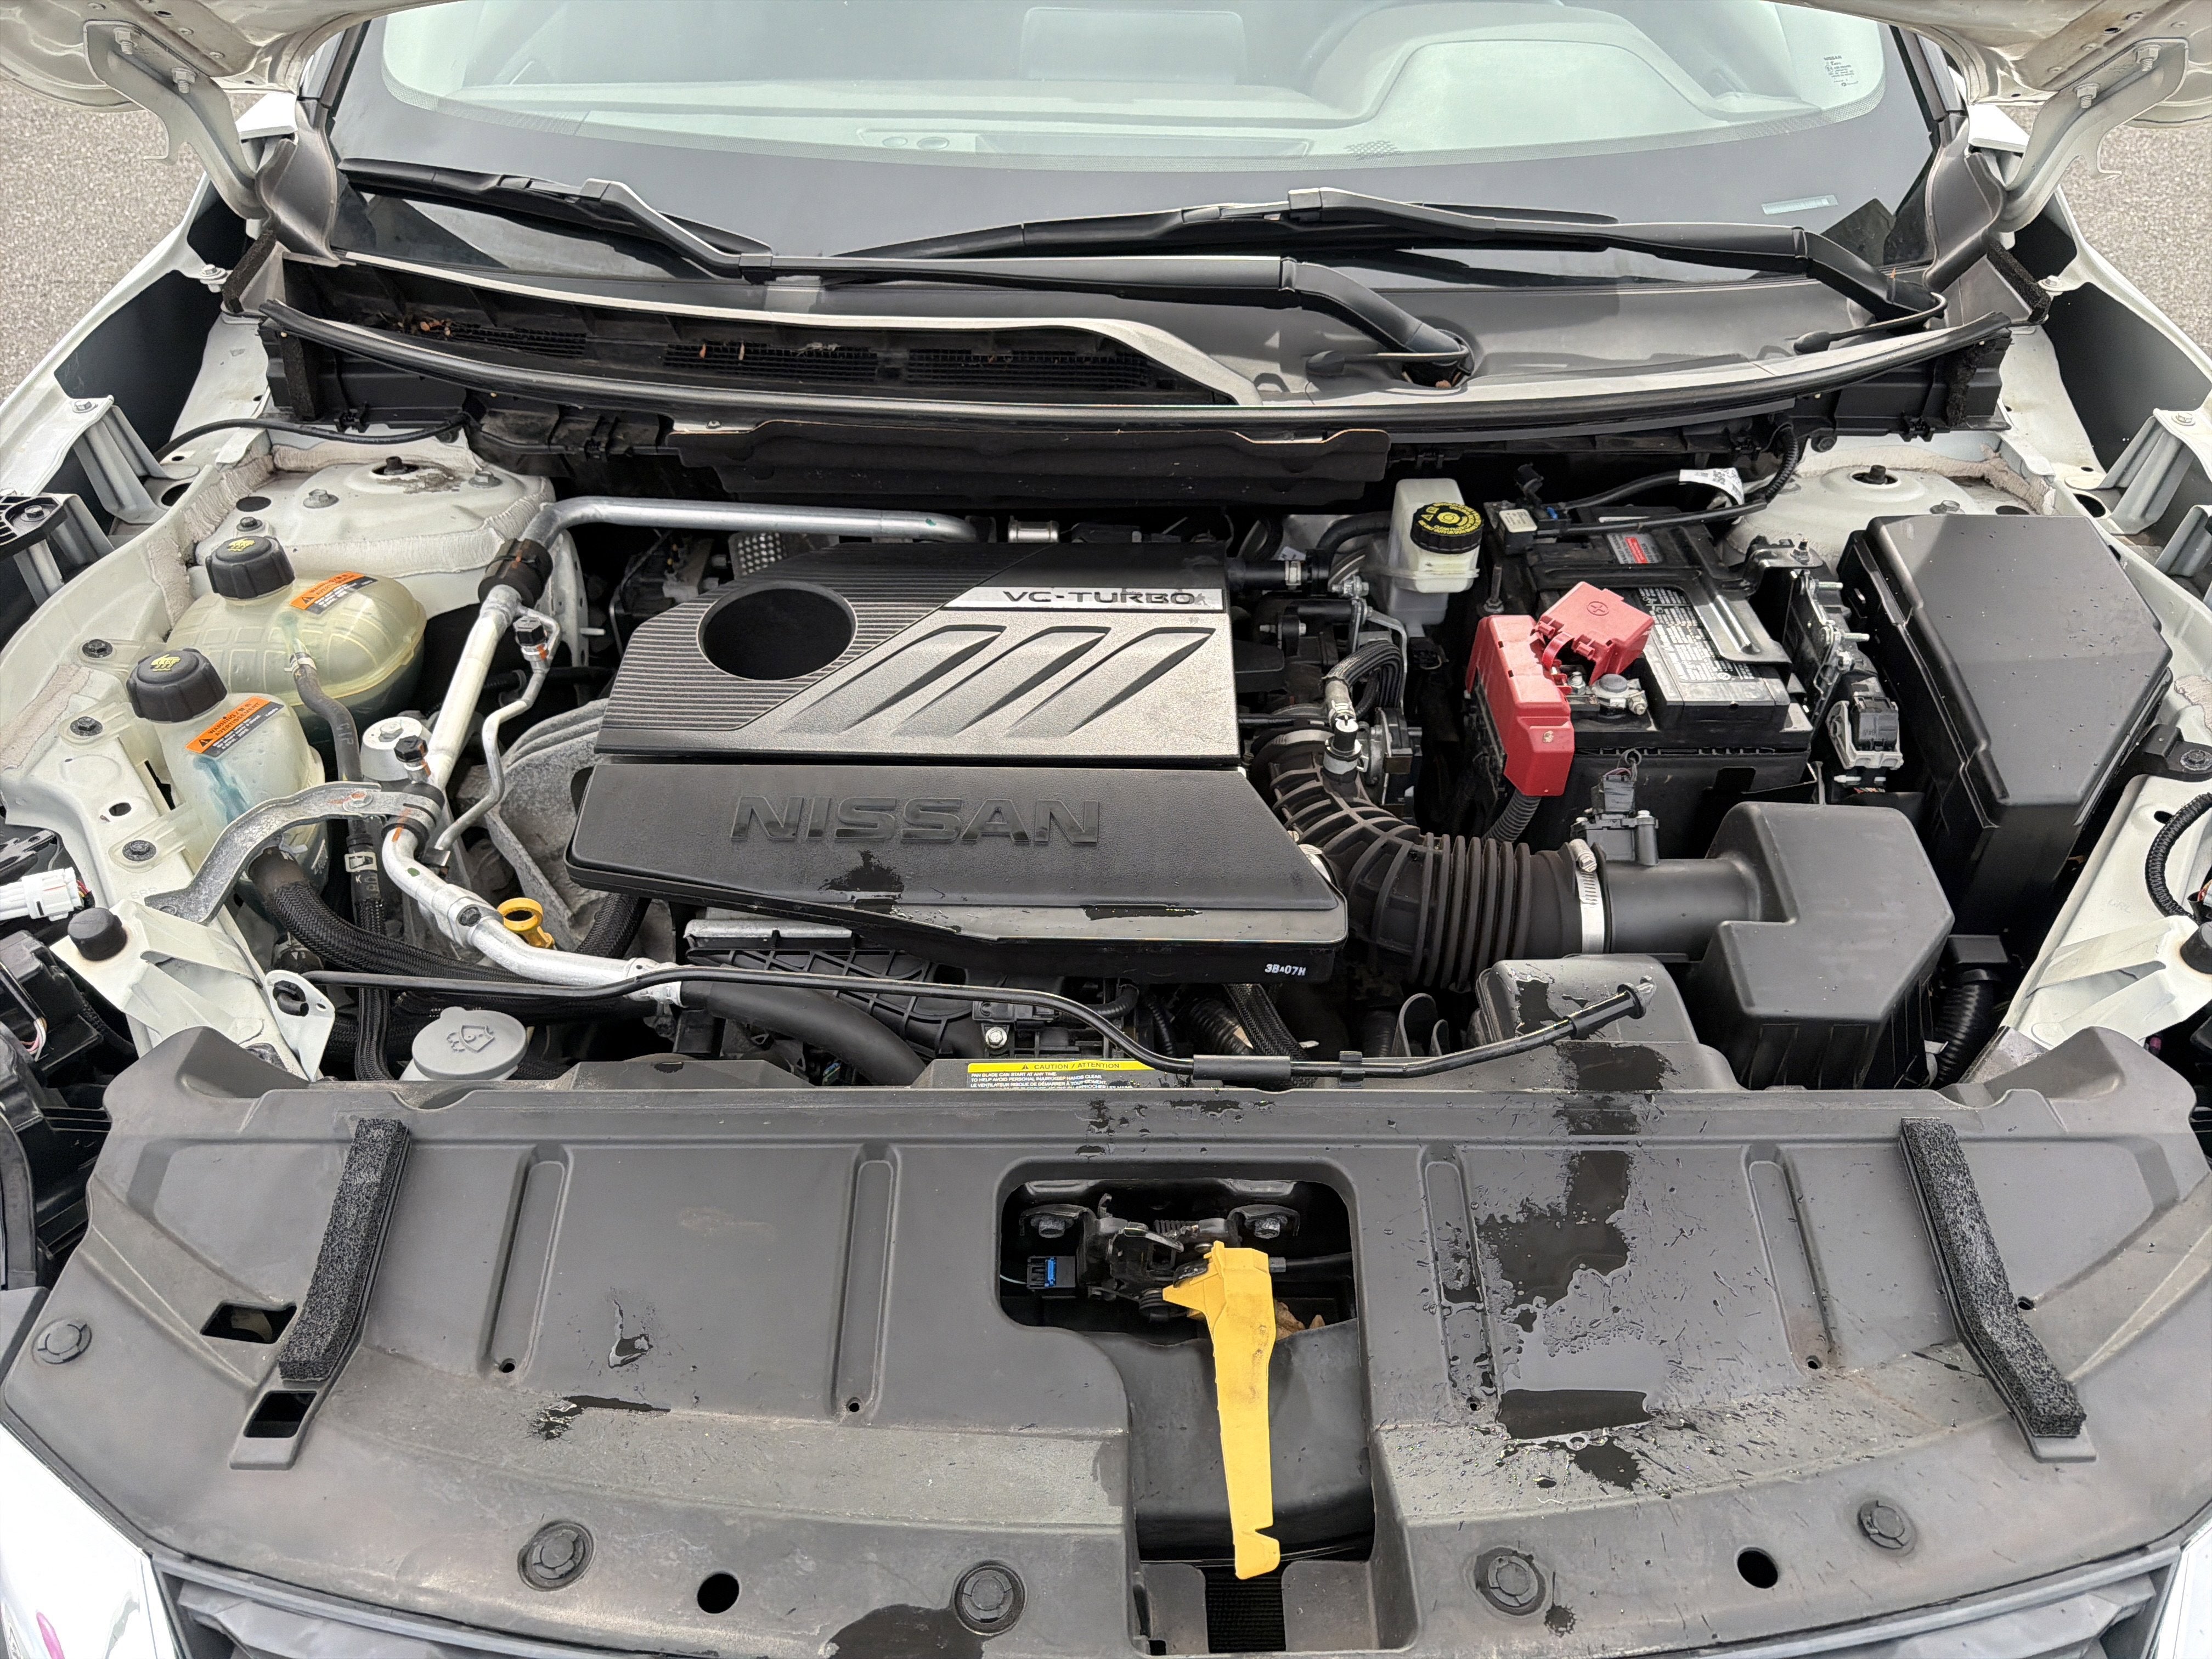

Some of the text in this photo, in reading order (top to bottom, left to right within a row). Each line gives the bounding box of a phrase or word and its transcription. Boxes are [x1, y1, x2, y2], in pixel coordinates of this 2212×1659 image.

[1003, 590, 1195, 604] VC-TURBO
[208, 714, 236, 734] WARNING
[215, 702, 260, 737] AVERTISSEMENT
[730, 797, 1099, 843] NISSAN
